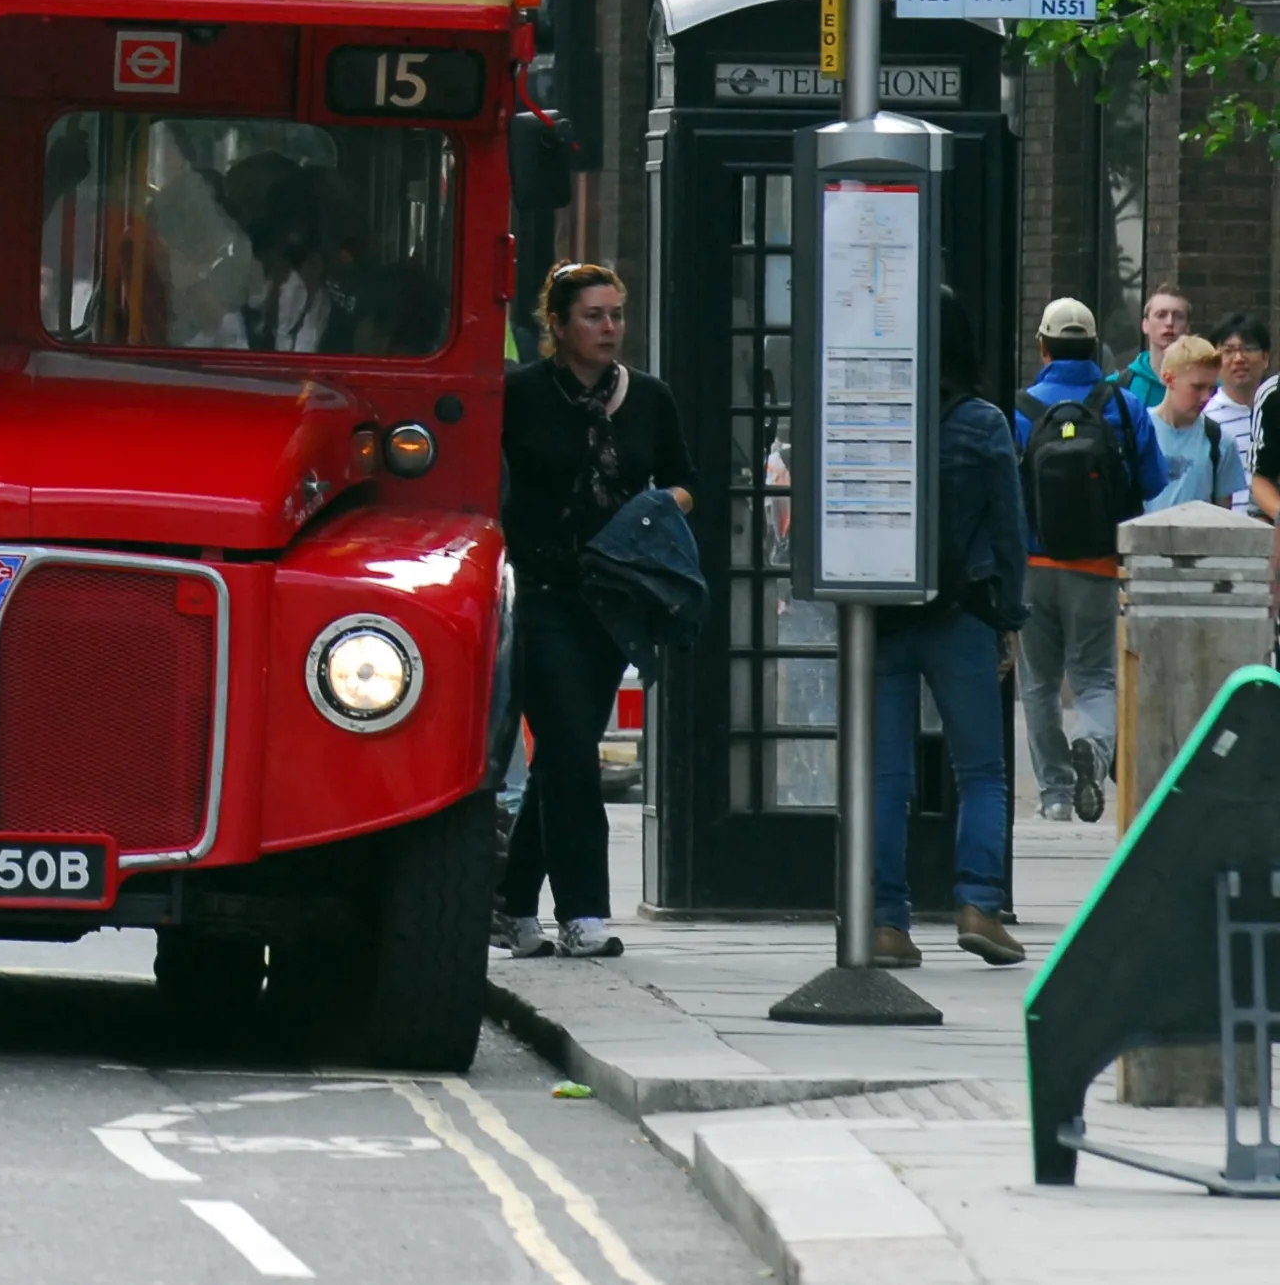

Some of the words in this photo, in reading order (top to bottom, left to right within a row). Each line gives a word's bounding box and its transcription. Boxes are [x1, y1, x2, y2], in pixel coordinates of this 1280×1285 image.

[1041, 0, 1085, 15] N551
[375, 53, 430, 107] 15
[772, 68, 960, 97] TELHONE
